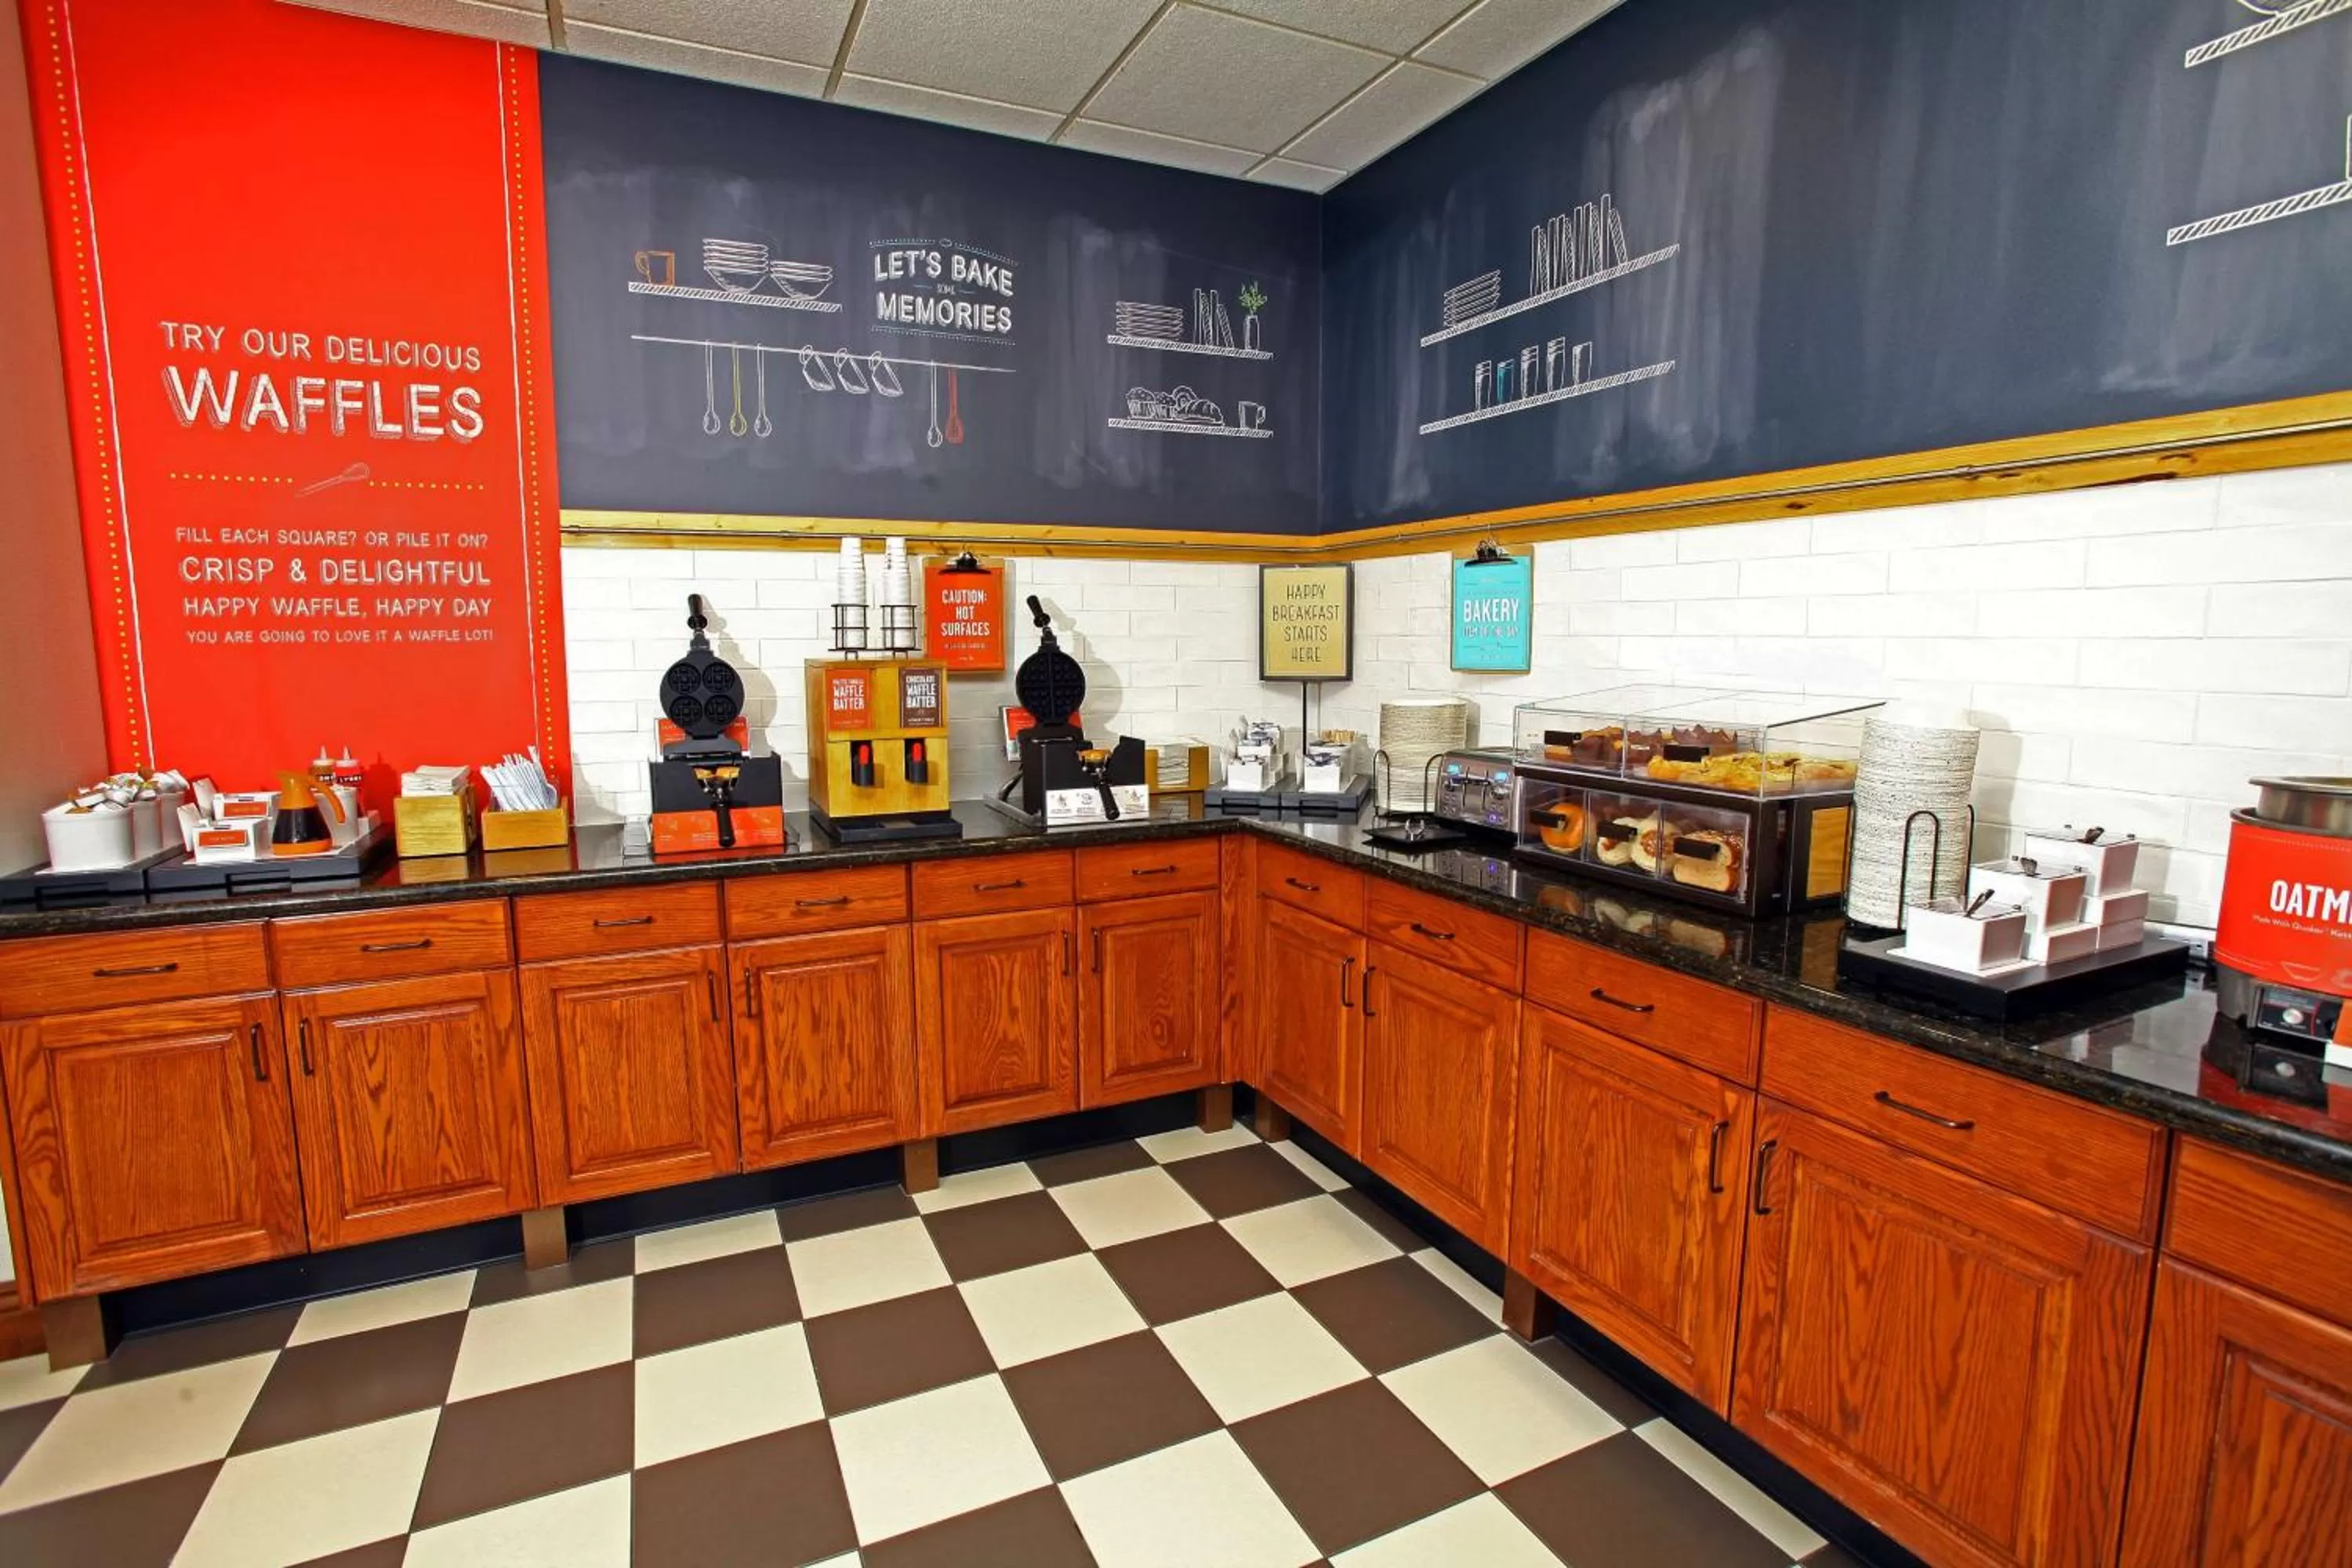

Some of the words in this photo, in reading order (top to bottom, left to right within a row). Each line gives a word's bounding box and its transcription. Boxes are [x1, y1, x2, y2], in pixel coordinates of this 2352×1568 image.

[874, 249, 942, 282] LET'S
[951, 255, 1014, 296] BAKE
[876, 291, 1012, 334] MEMORIES
[161, 321, 225, 351] TRY
[242, 328, 312, 359] OUR
[324, 336, 481, 372] DELICIOUS
[162, 365, 484, 444] WAFFLES
[176, 527, 212, 543] FILL
[220, 528, 269, 545] EACH
[278, 529, 356, 547] SQUARE?
[364, 532, 389, 547] OR
[397, 532, 430, 547] PILE
[436, 533, 451, 547] IT
[458, 534, 488, 548] ON?
[180, 557, 274, 582] CRISP
[289, 559, 307, 583] &
[321, 559, 492, 586] DELIGHTFUL
[941, 589, 988, 605] CAUTION:
[1287, 583, 1326, 601] HAPPY
[183, 597, 260, 616] HAPPY
[271, 597, 367, 619] WAFFLE,
[376, 597, 444, 616] HAPPY
[452, 598, 492, 617] DAY
[956, 606, 975, 620] HOT
[1272, 604, 1340, 622] BREAKFAST
[1464, 598, 1519, 622] BAKERY
[187, 630, 217, 644] YOU
[224, 630, 253, 643] ARE
[260, 630, 306, 643] GOING
[313, 630, 330, 642] TO
[336, 630, 371, 642] LOVE
[376, 630, 389, 642] IT
[394, 630, 403, 641] A
[408, 630, 460, 641] WAFFLE
[464, 629, 494, 641] LOT!
[941, 622, 990, 637] SURFACES
[1284, 625, 1327, 642] STARTS
[1291, 647, 1323, 662] HERE
[833, 684, 865, 697] WAFFLE
[906, 683, 937, 695] WAFFLE
[833, 698, 865, 711] BATTER
[906, 696, 936, 708] BATTER
[2270, 879, 2352, 924] OATM
